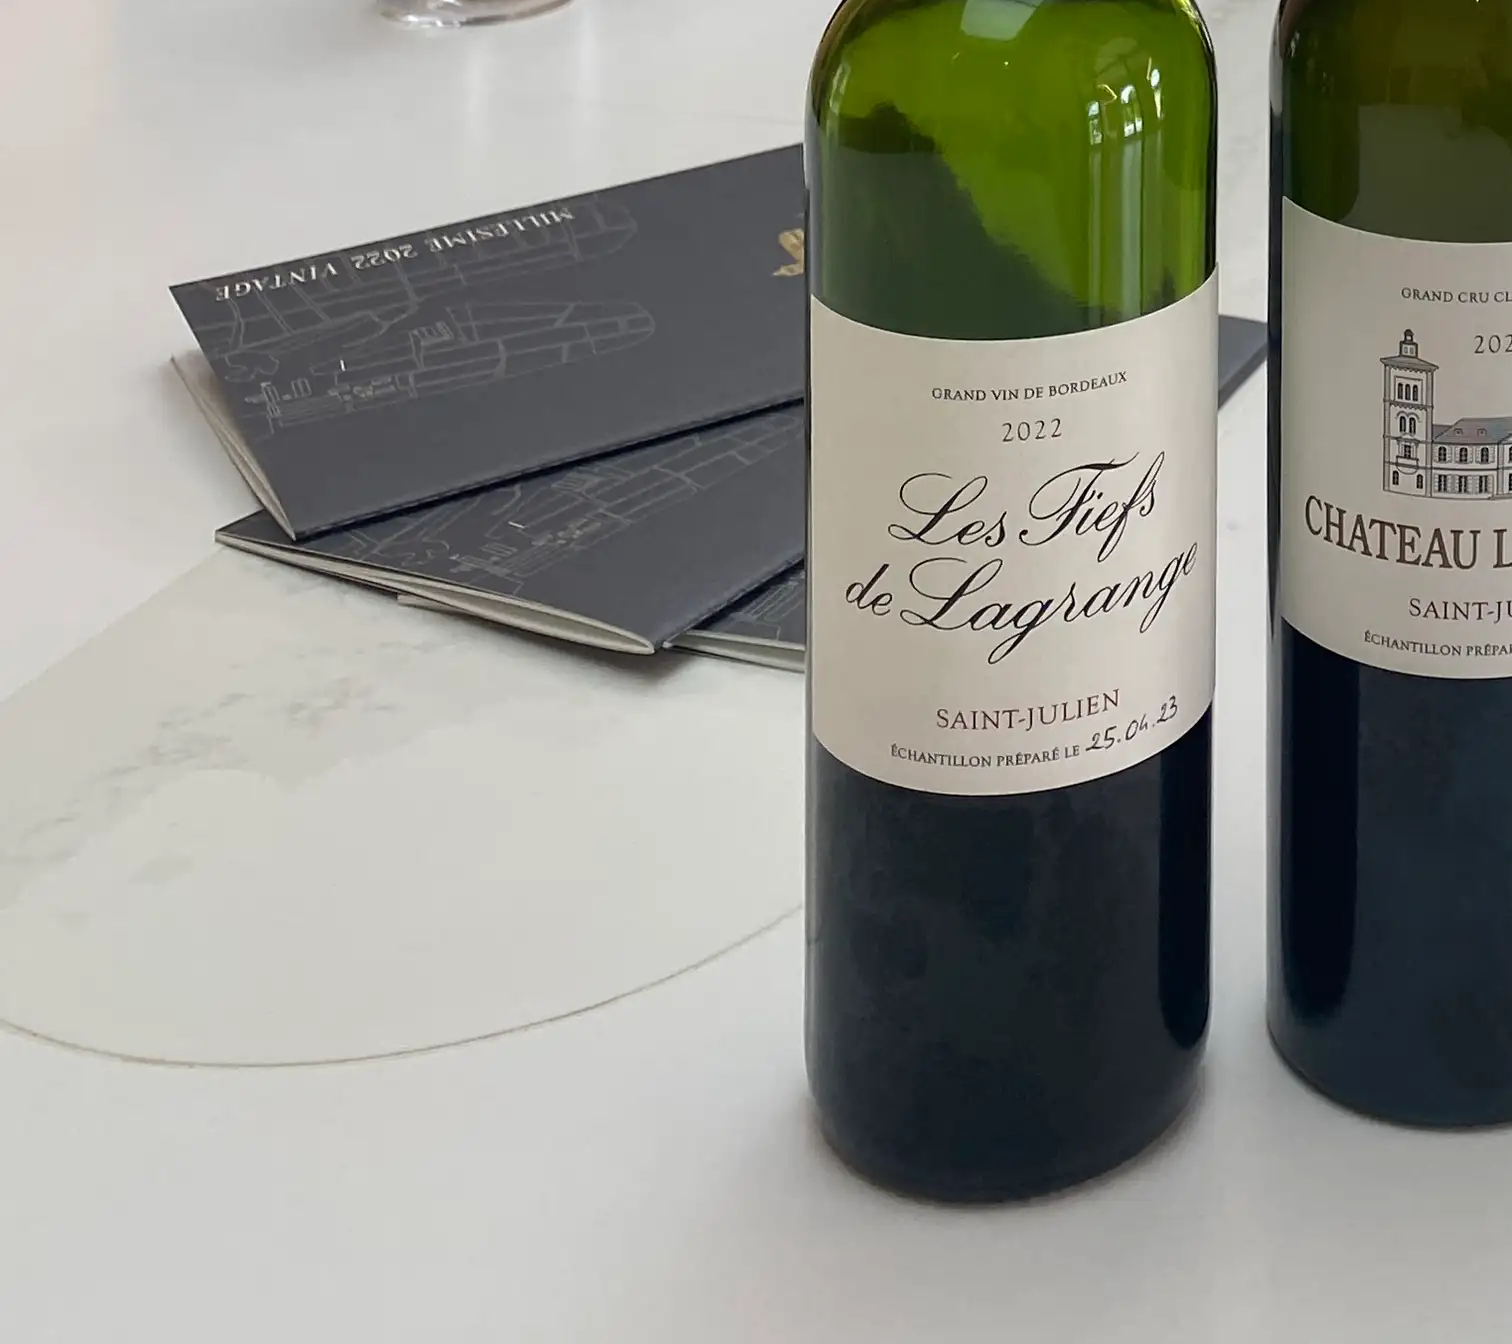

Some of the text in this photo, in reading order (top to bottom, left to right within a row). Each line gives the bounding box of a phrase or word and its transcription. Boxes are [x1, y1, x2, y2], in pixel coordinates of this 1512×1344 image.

[350, 243, 419, 271] 2022
[215, 261, 339, 302] VINTAGE
[1401, 287, 1454, 303] GRAND
[1457, 291, 1490, 304] CRU
[931, 370, 1128, 402] GRAND VIN DE BORDEAUX
[1001, 417, 1062, 443] 2022
[888, 451, 1165, 563] Les Fiefs
[1304, 495, 1481, 570] CHATEAU
[845, 542, 1198, 665] de Lagrange
[1363, 629, 1462, 657] ÉCHANTILLON
[936, 688, 1120, 731] SAINT-JULIEN
[890, 743, 992, 768] ÉCHANTILLON
[996, 746, 1060, 768] PRÉPARÉ
[1064, 744, 1081, 759] LE
